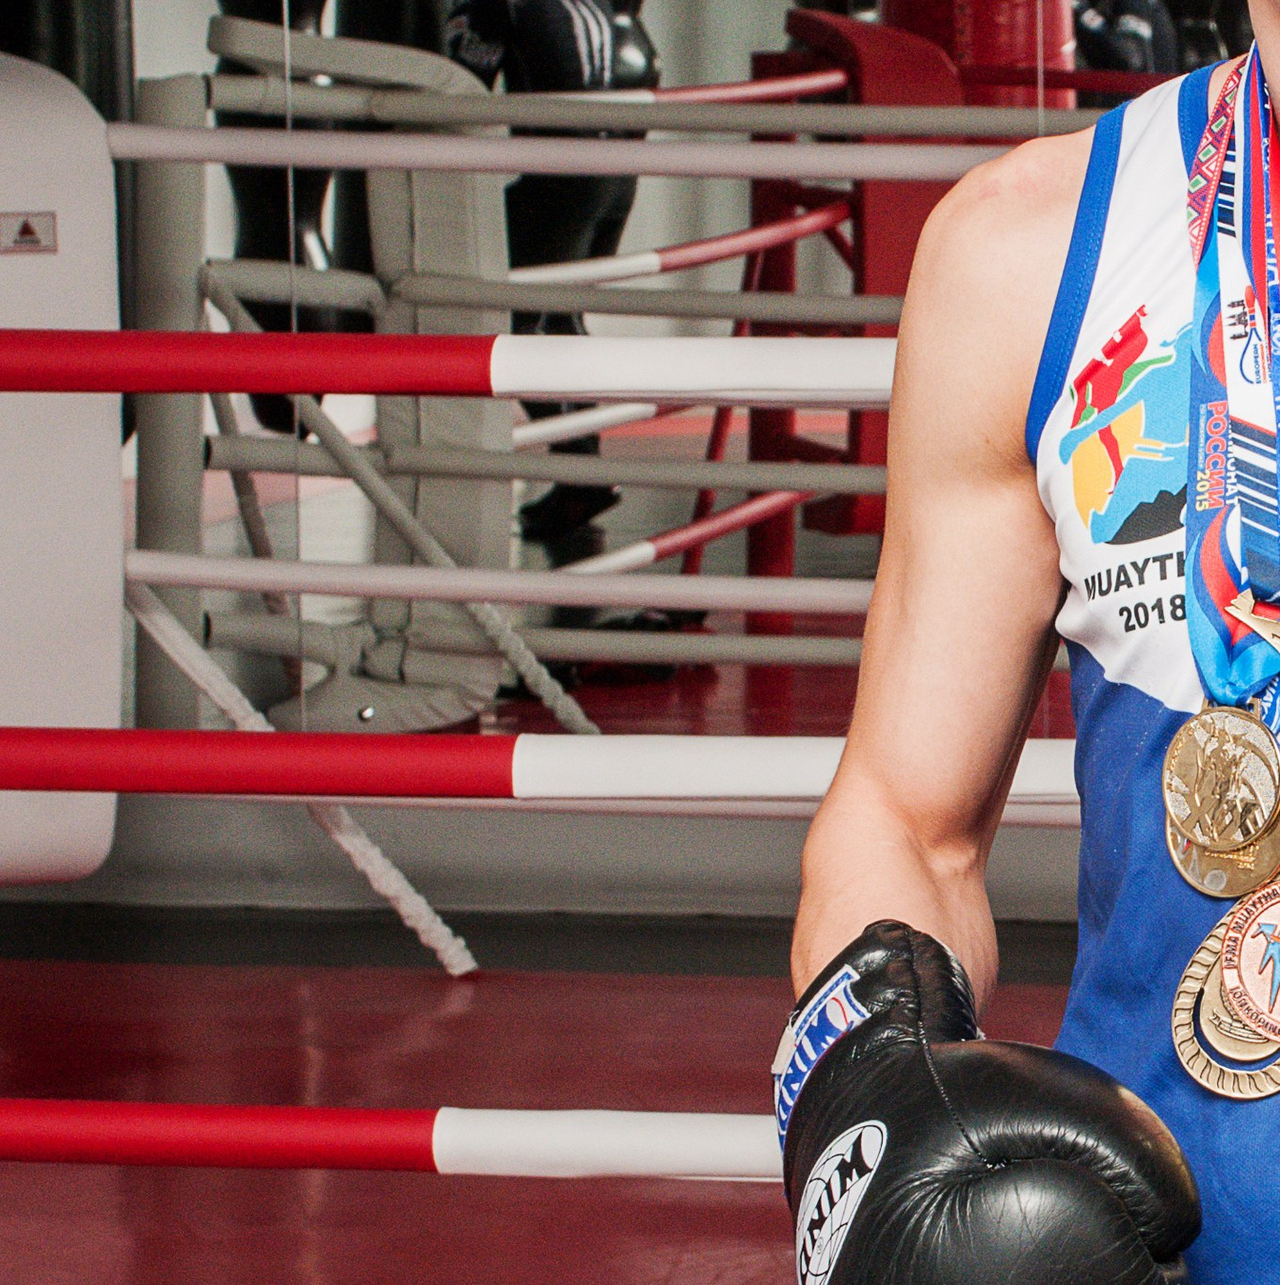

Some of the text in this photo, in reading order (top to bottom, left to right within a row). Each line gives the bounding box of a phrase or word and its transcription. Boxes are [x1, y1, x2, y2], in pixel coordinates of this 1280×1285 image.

[1207, 401, 1229, 510] РОССИИ
[1195, 469, 1211, 513] 2015
[1119, 594, 1186, 633] 2018
[1224, 937, 1239, 969] IFMA
